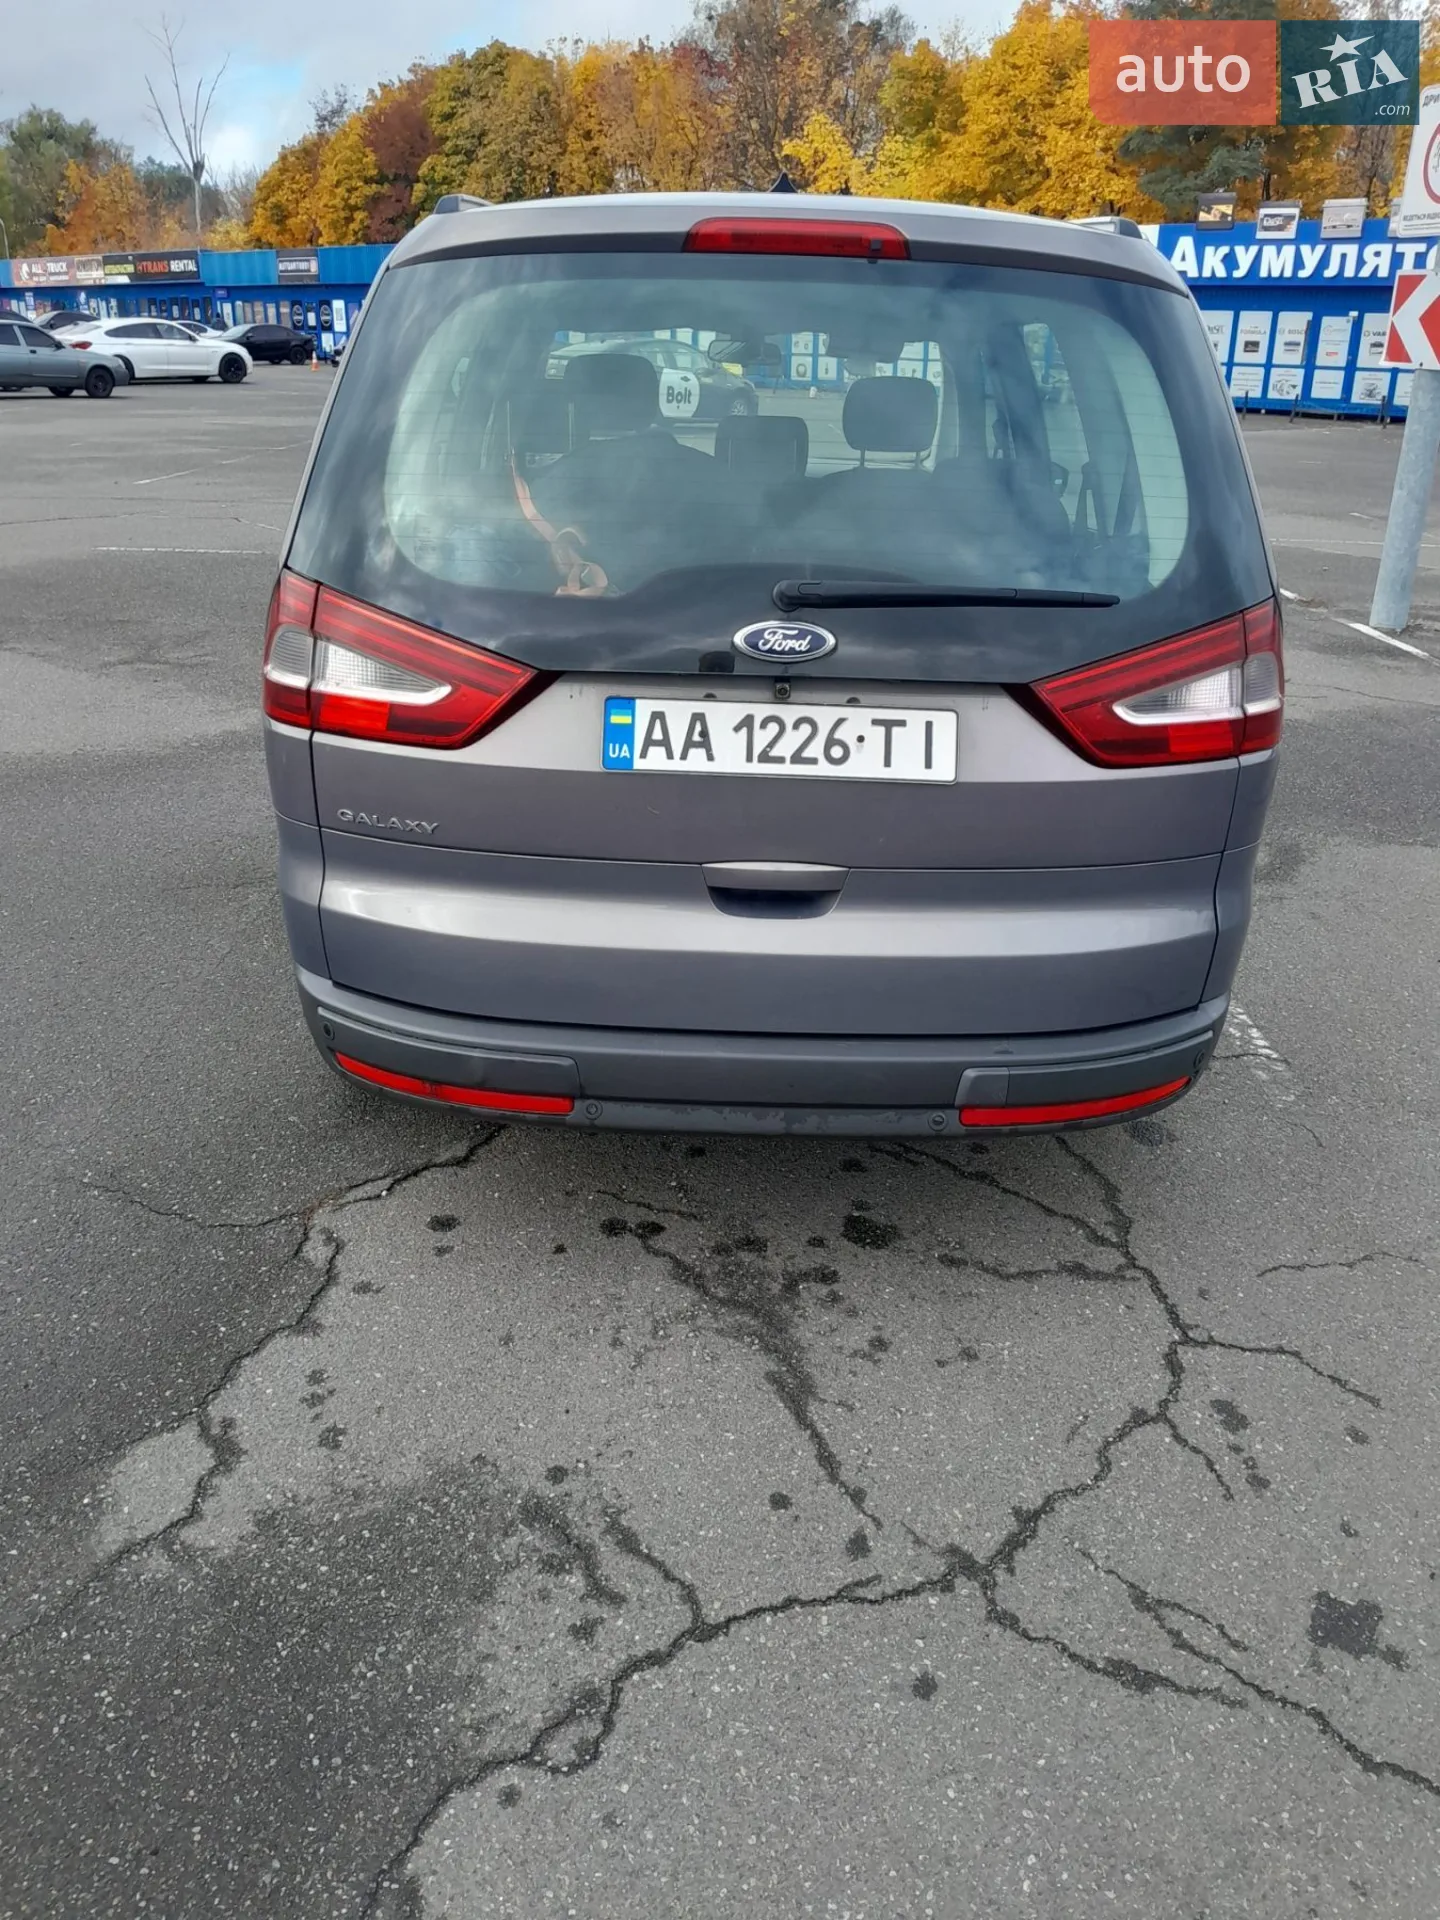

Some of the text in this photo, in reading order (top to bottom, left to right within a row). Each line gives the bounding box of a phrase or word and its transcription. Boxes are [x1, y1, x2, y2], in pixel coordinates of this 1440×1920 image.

[46, 262, 68, 273] TRUCK
[170, 259, 198, 272] RENTAL
[666, 385, 692, 405] Bolt
[758, 628, 810, 653] Ford
[639, 710, 716, 762] AA
[733, 713, 851, 766] 1226
[609, 743, 631, 760] UA
[336, 808, 440, 835] GALAXY
